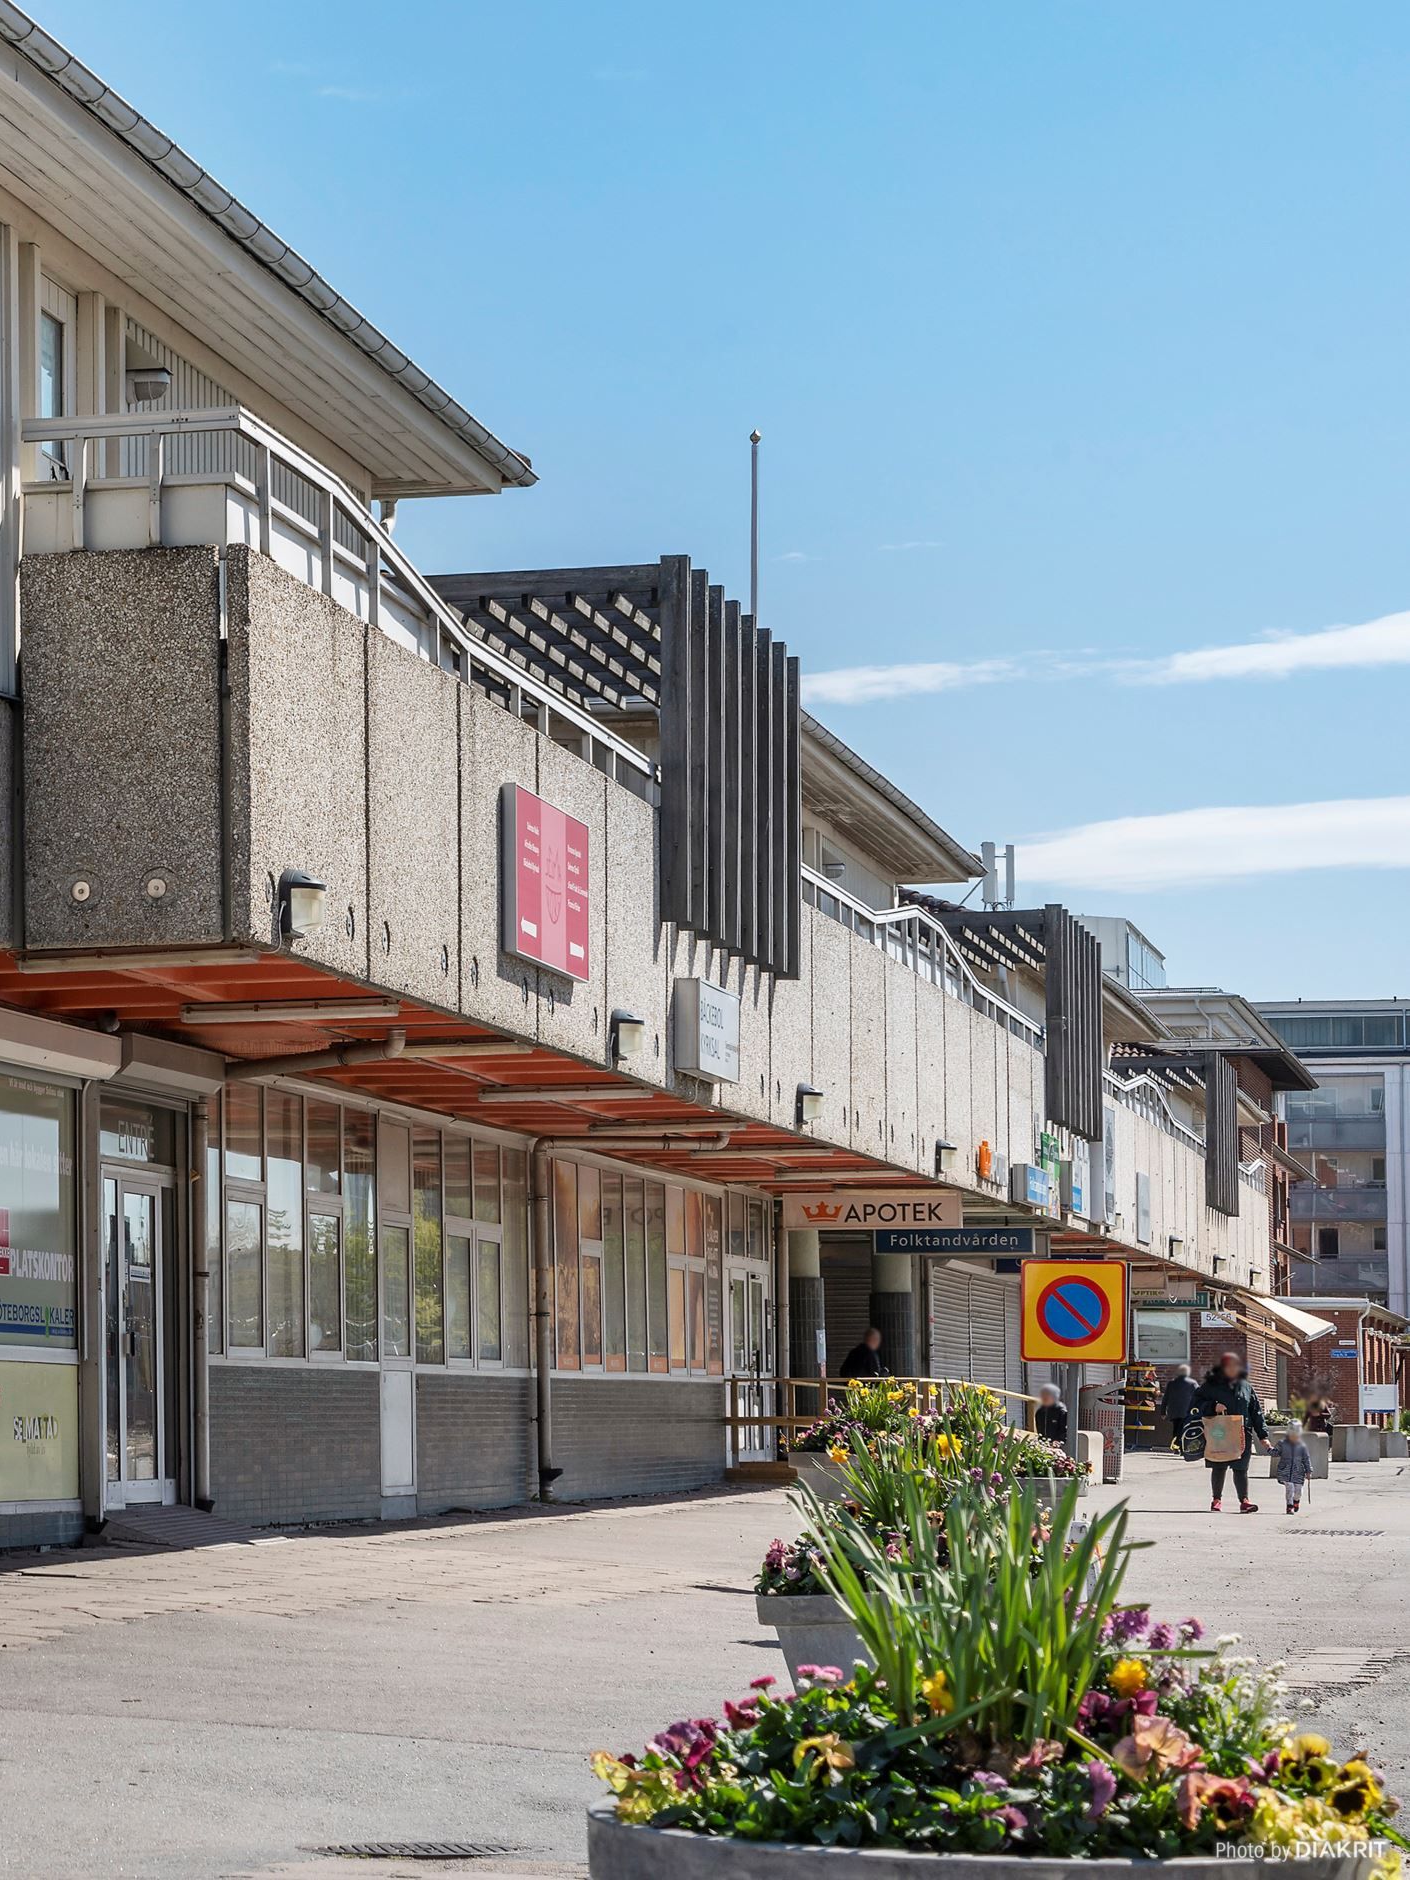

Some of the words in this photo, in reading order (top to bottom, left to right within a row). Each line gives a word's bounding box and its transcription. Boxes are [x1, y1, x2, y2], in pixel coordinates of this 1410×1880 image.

[844, 1202, 943, 1223] APOTEK
[890, 1233, 1019, 1247] Folktandvården
[10, 1248, 75, 1283] PLATSKONTOR
